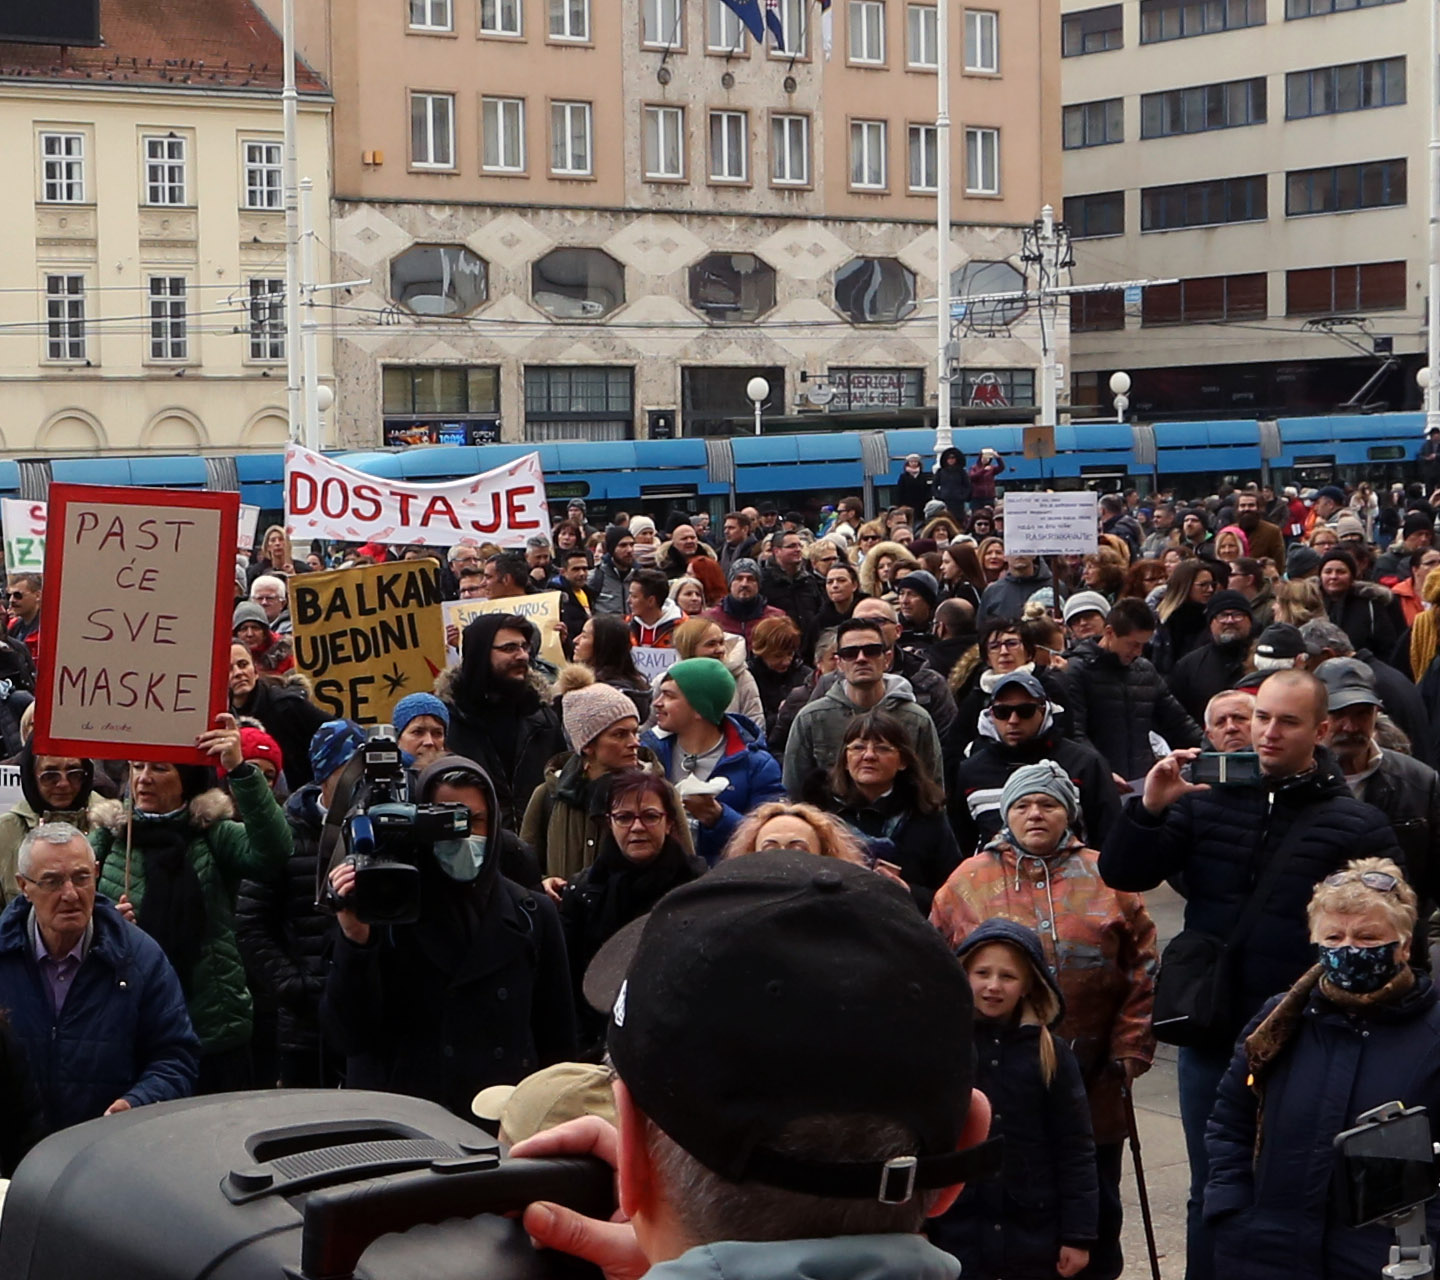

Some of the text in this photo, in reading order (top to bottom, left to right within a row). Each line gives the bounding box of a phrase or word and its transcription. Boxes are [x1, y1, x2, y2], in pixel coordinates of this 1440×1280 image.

[835, 374, 906, 389] AMERICAN
[76, 511, 195, 553] PAST
[115, 558, 160, 592] ĆE
[294, 566, 443, 625] BALKAN
[81, 608, 179, 646] SVE
[294, 612, 420, 678] UJEDINI
[58, 665, 198, 713] MASKE
[313, 675, 378, 724] SE
